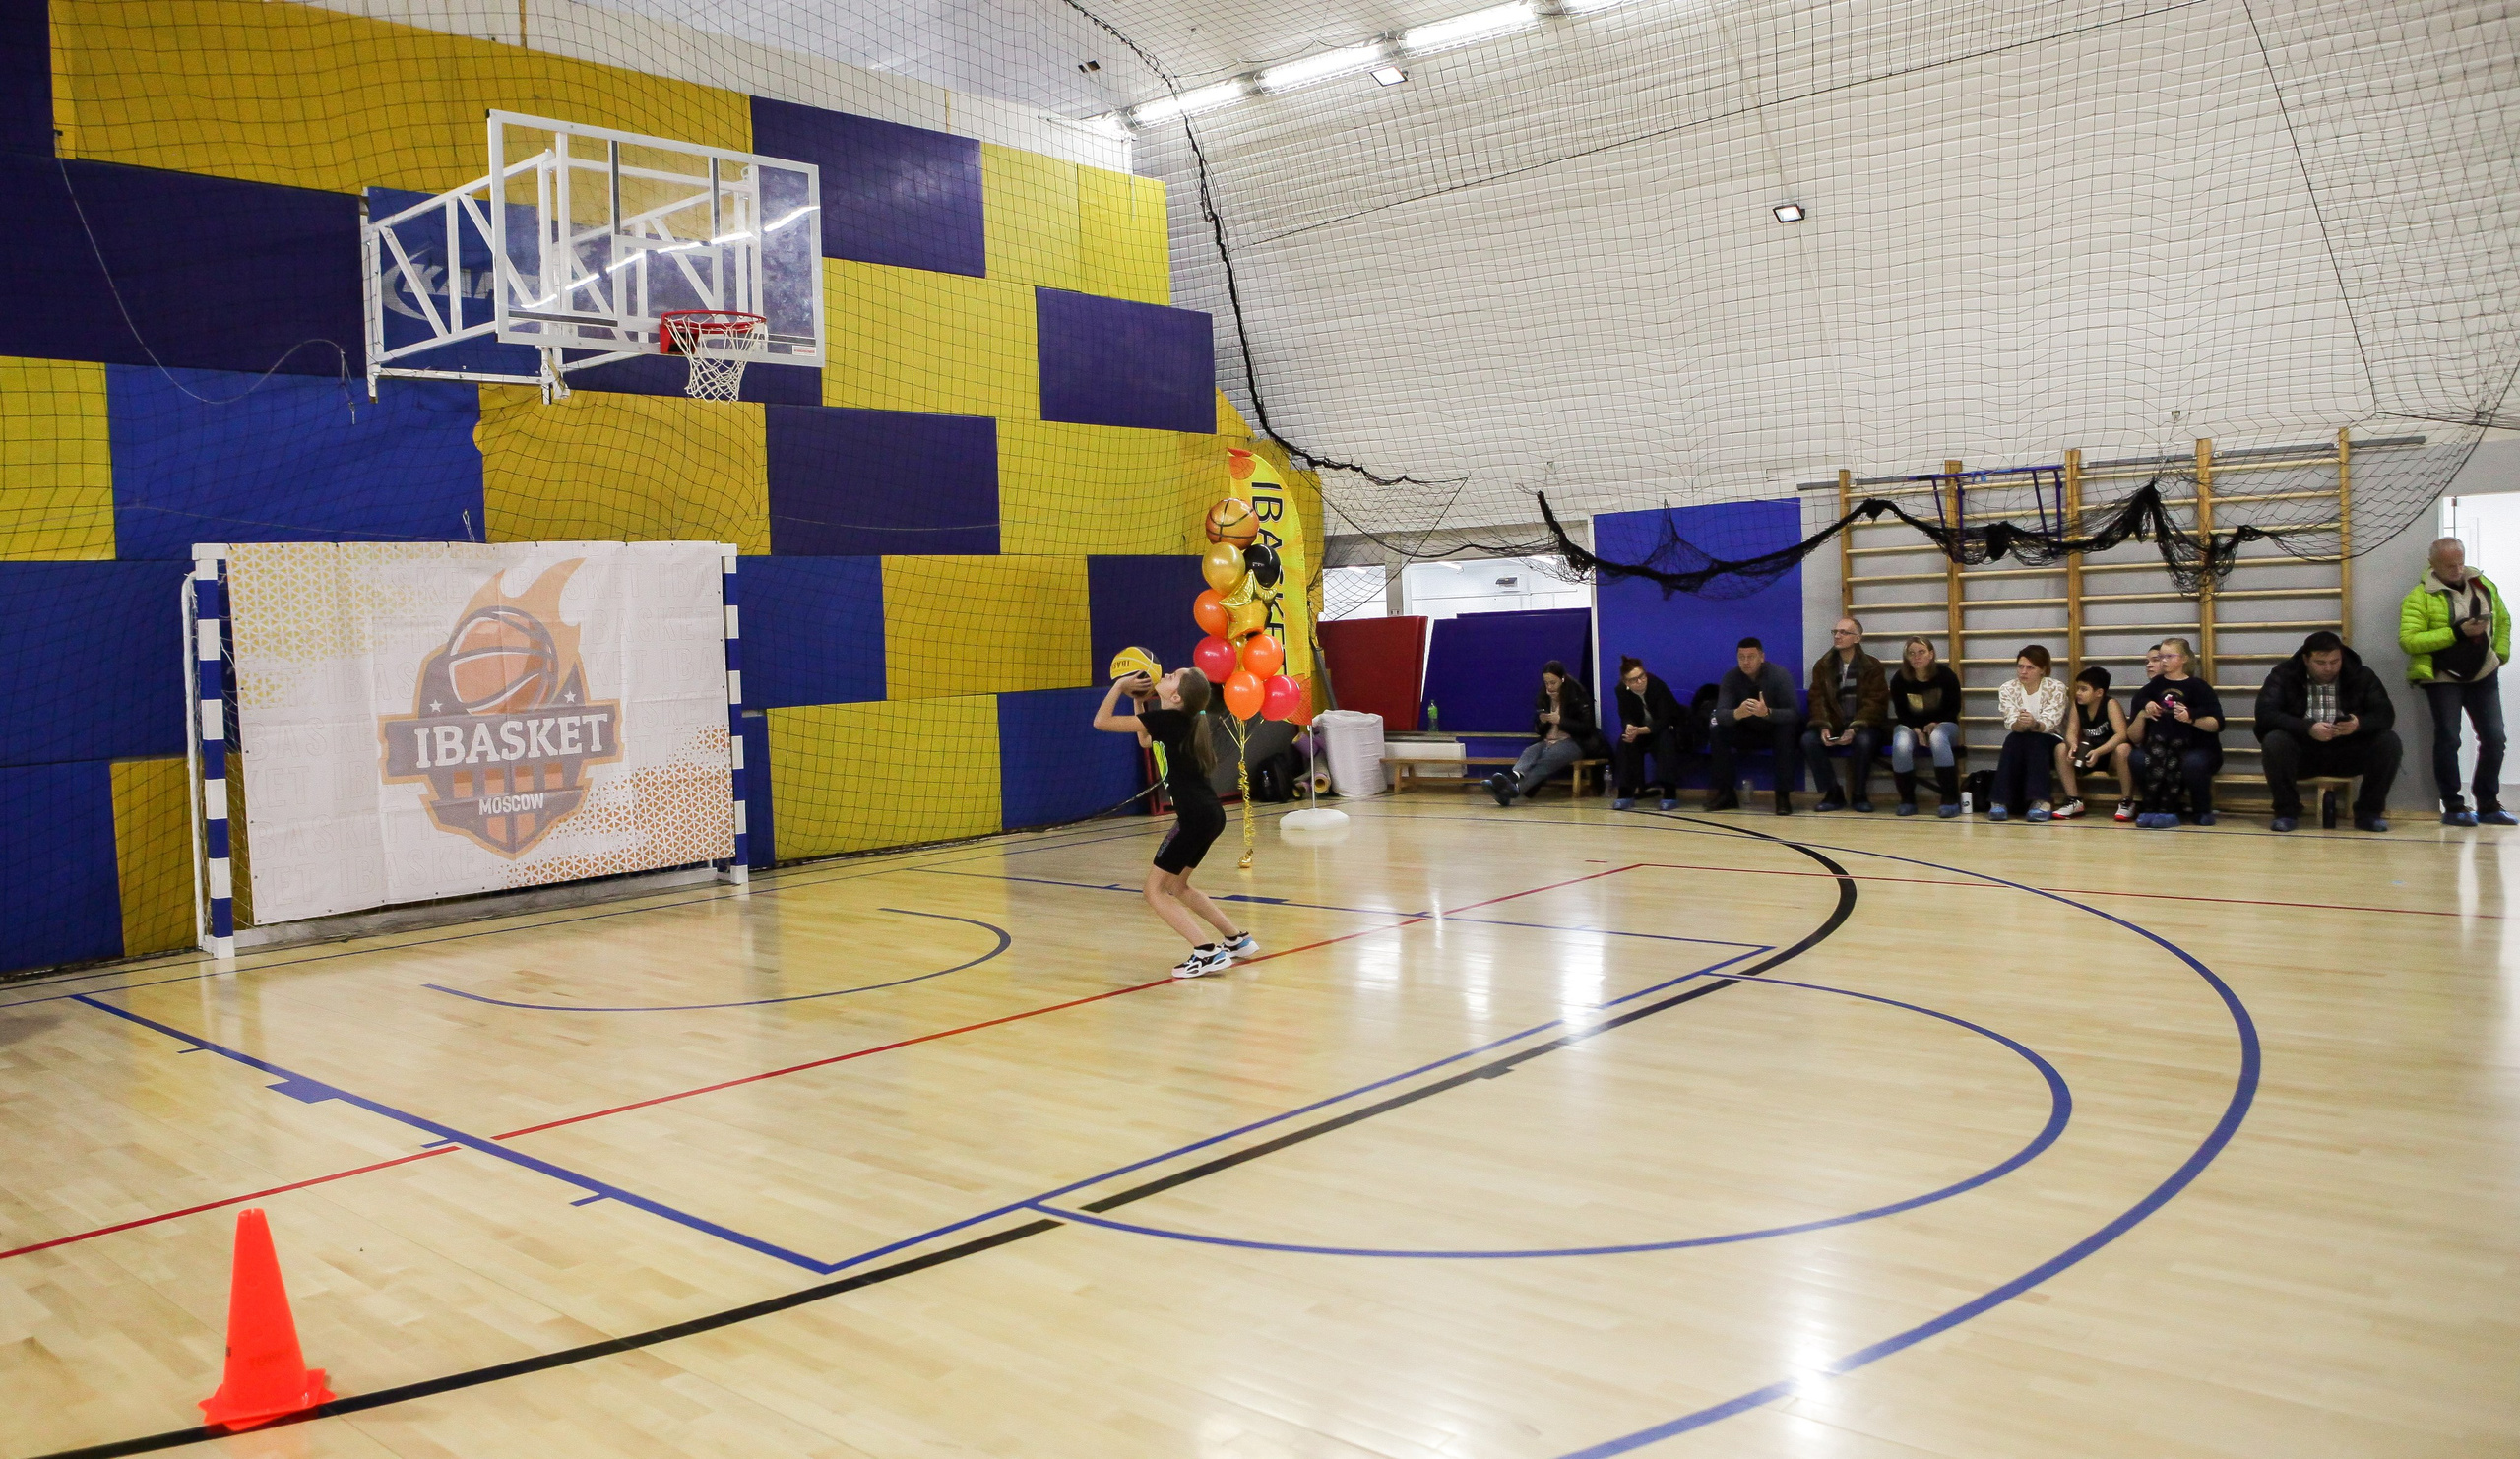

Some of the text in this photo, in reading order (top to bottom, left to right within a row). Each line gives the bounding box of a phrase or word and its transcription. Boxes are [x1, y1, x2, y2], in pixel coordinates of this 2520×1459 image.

[1250, 480, 1288, 676] IBAKE
[413, 713, 608, 769] IBASKET
[478, 793, 544, 815] MOSCOW
